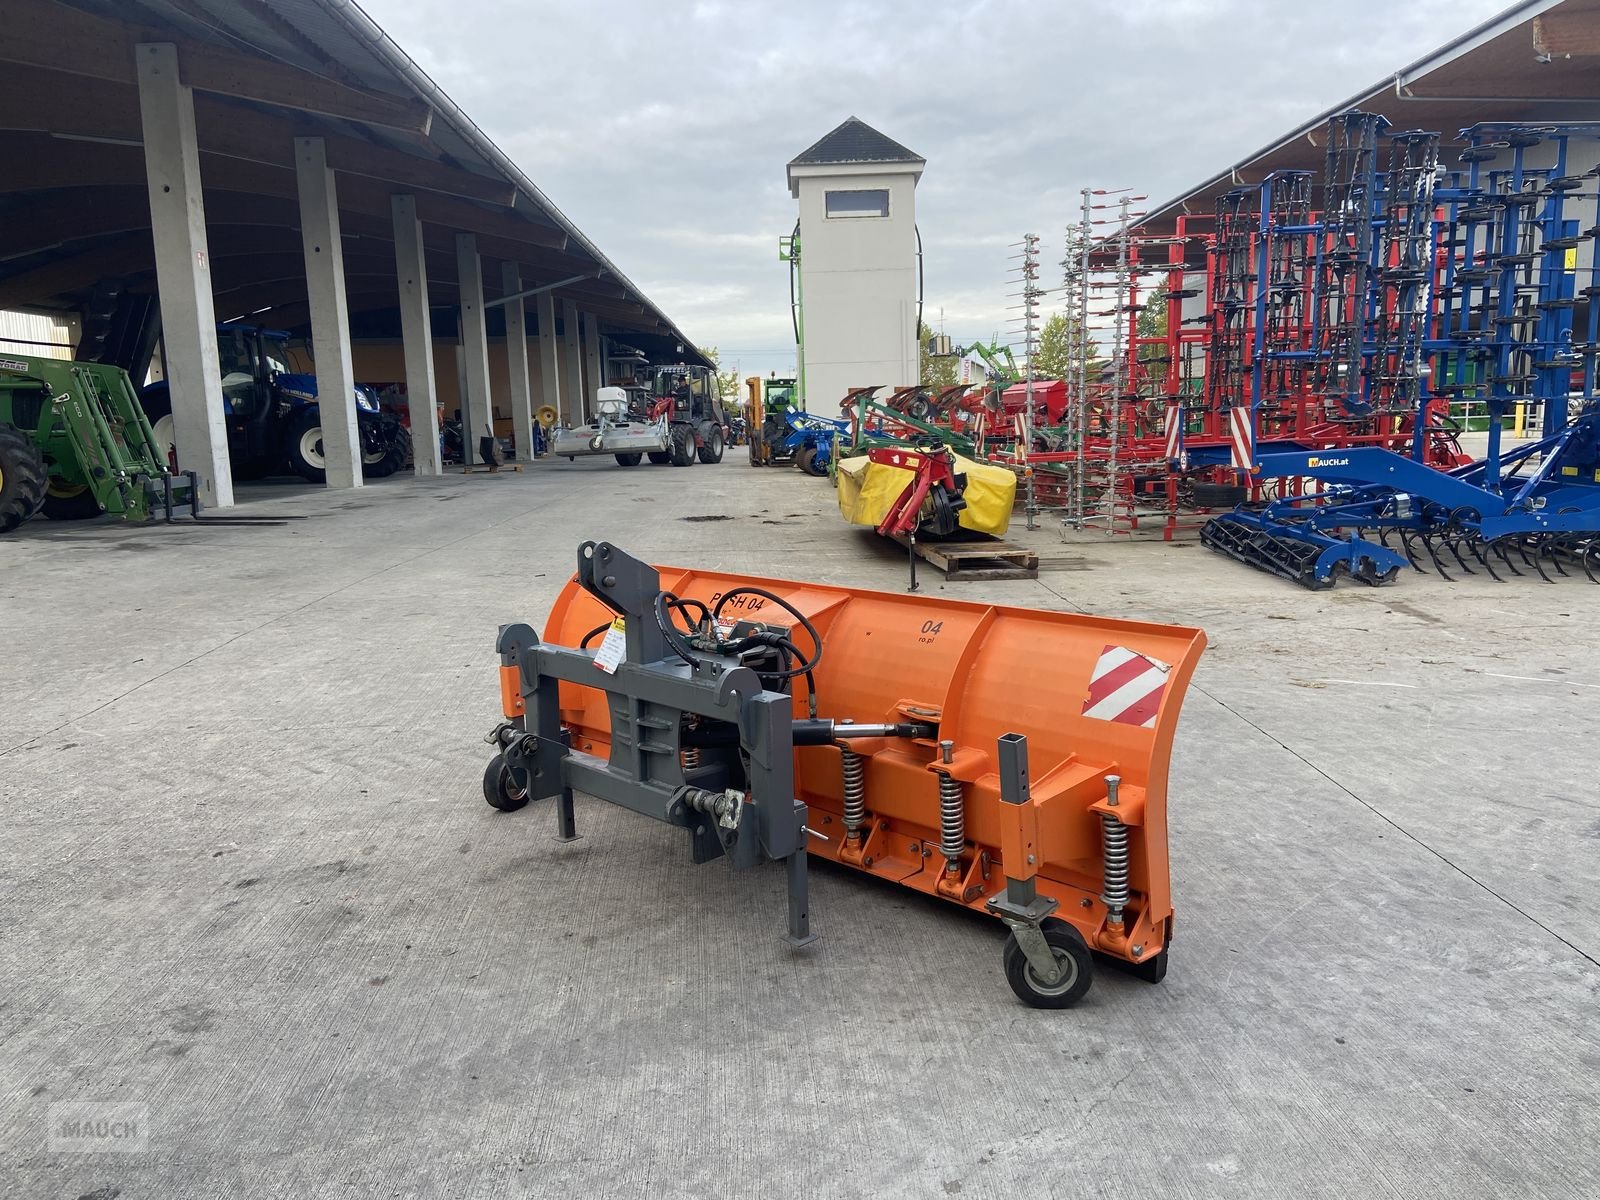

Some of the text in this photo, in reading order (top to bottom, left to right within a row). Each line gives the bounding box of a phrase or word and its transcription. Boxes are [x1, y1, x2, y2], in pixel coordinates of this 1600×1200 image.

[0, 362, 26, 371] YDRAC
[710, 592, 766, 612] PSH 04
[921, 620, 943, 635] 04
